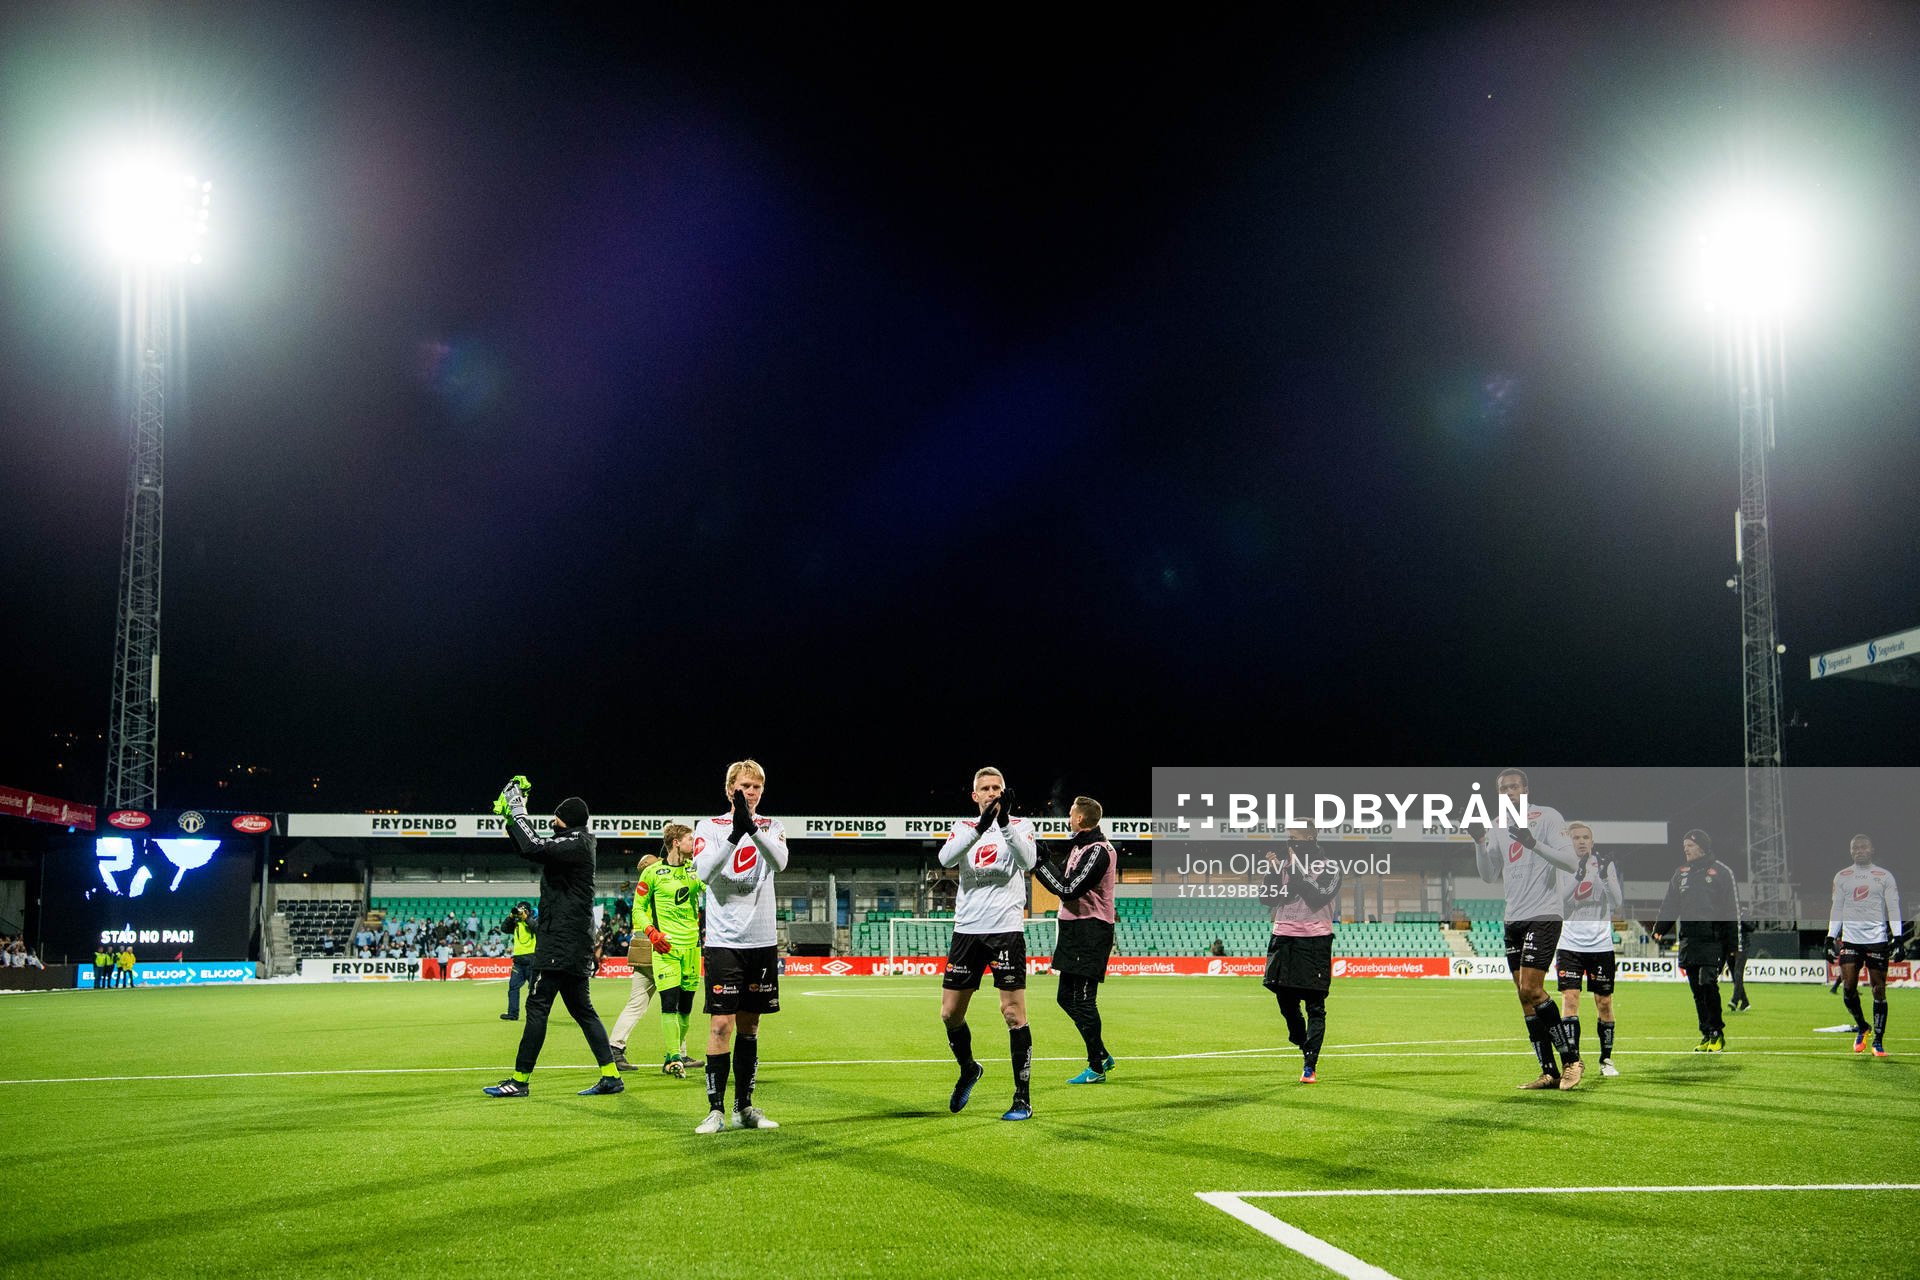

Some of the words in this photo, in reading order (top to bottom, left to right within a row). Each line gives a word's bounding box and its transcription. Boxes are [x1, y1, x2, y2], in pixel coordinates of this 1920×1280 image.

[372, 818, 457, 831] FRYDENBØ
[806, 819, 887, 832] FRYDENBØ
[905, 820, 955, 832] FRYDE
[139, 930, 160, 943] NO
[999, 950, 1009, 961] 41
[762, 967, 768, 979] 7
[1347, 963, 1423, 975] SparebankenVest
[1779, 967, 1797, 977] NO
